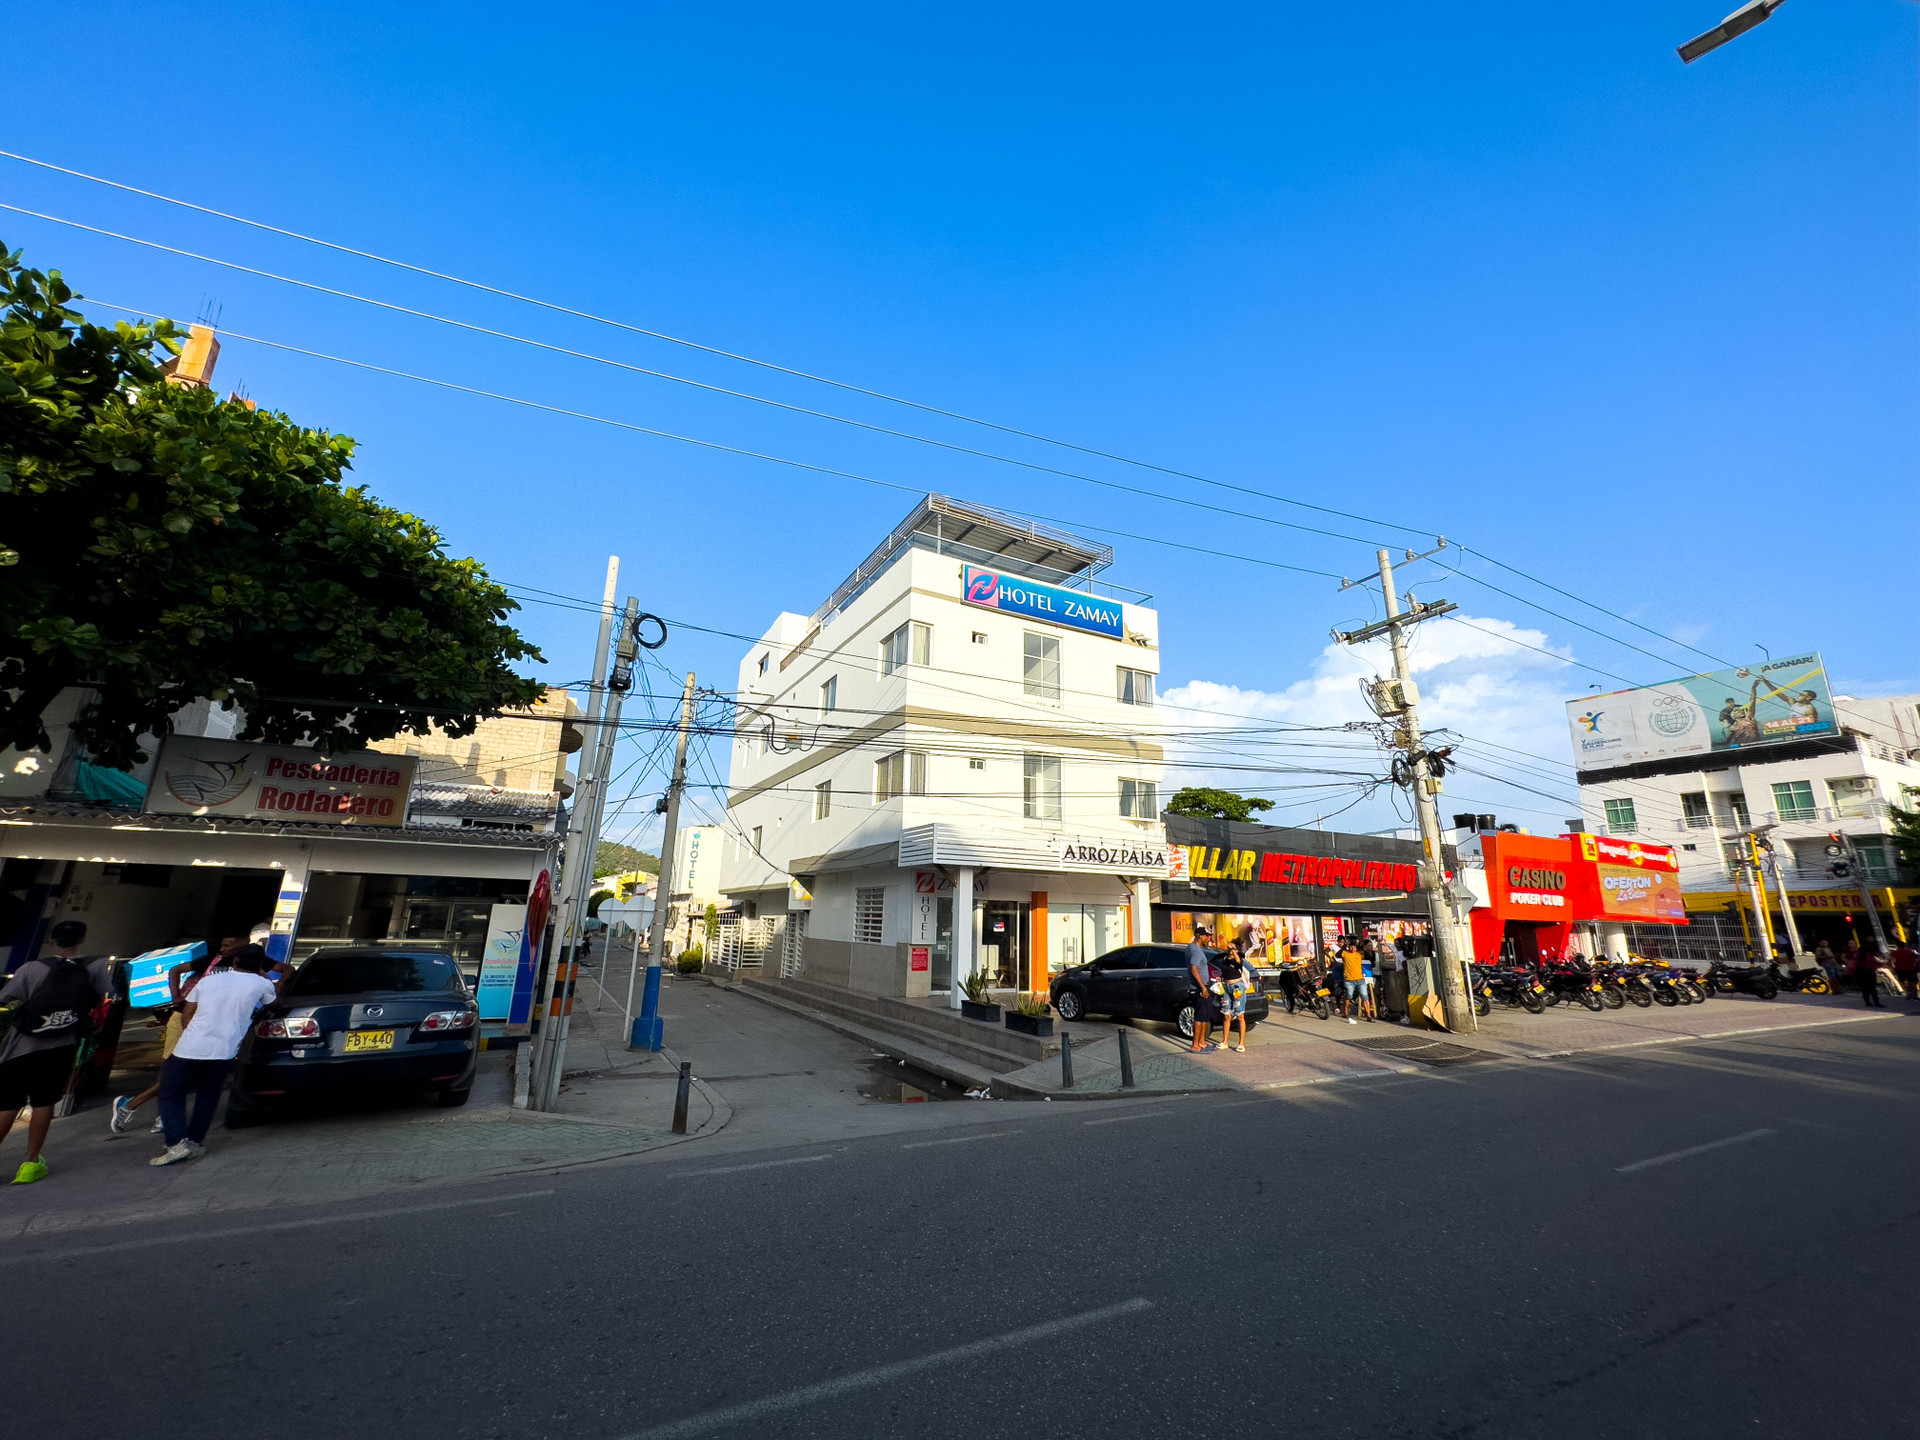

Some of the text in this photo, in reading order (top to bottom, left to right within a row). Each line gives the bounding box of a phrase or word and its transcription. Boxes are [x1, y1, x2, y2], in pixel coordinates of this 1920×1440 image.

[999, 585, 1120, 628] HOTEL ZAMAY
[1781, 718, 1797, 726] AL
[1797, 721, 1830, 733] 2023
[265, 756, 401, 786] Pescaderia
[257, 786, 396, 817] Rodadero
[688, 840, 700, 889] HOTEL
[1259, 852, 1417, 892] METROPOLITANO
[1508, 866, 1566, 890] CASINO
[1510, 892, 1564, 906] POKER CLUB
[920, 896, 931, 940] HOTEL
[347, 1033, 393, 1047] FBY-440
